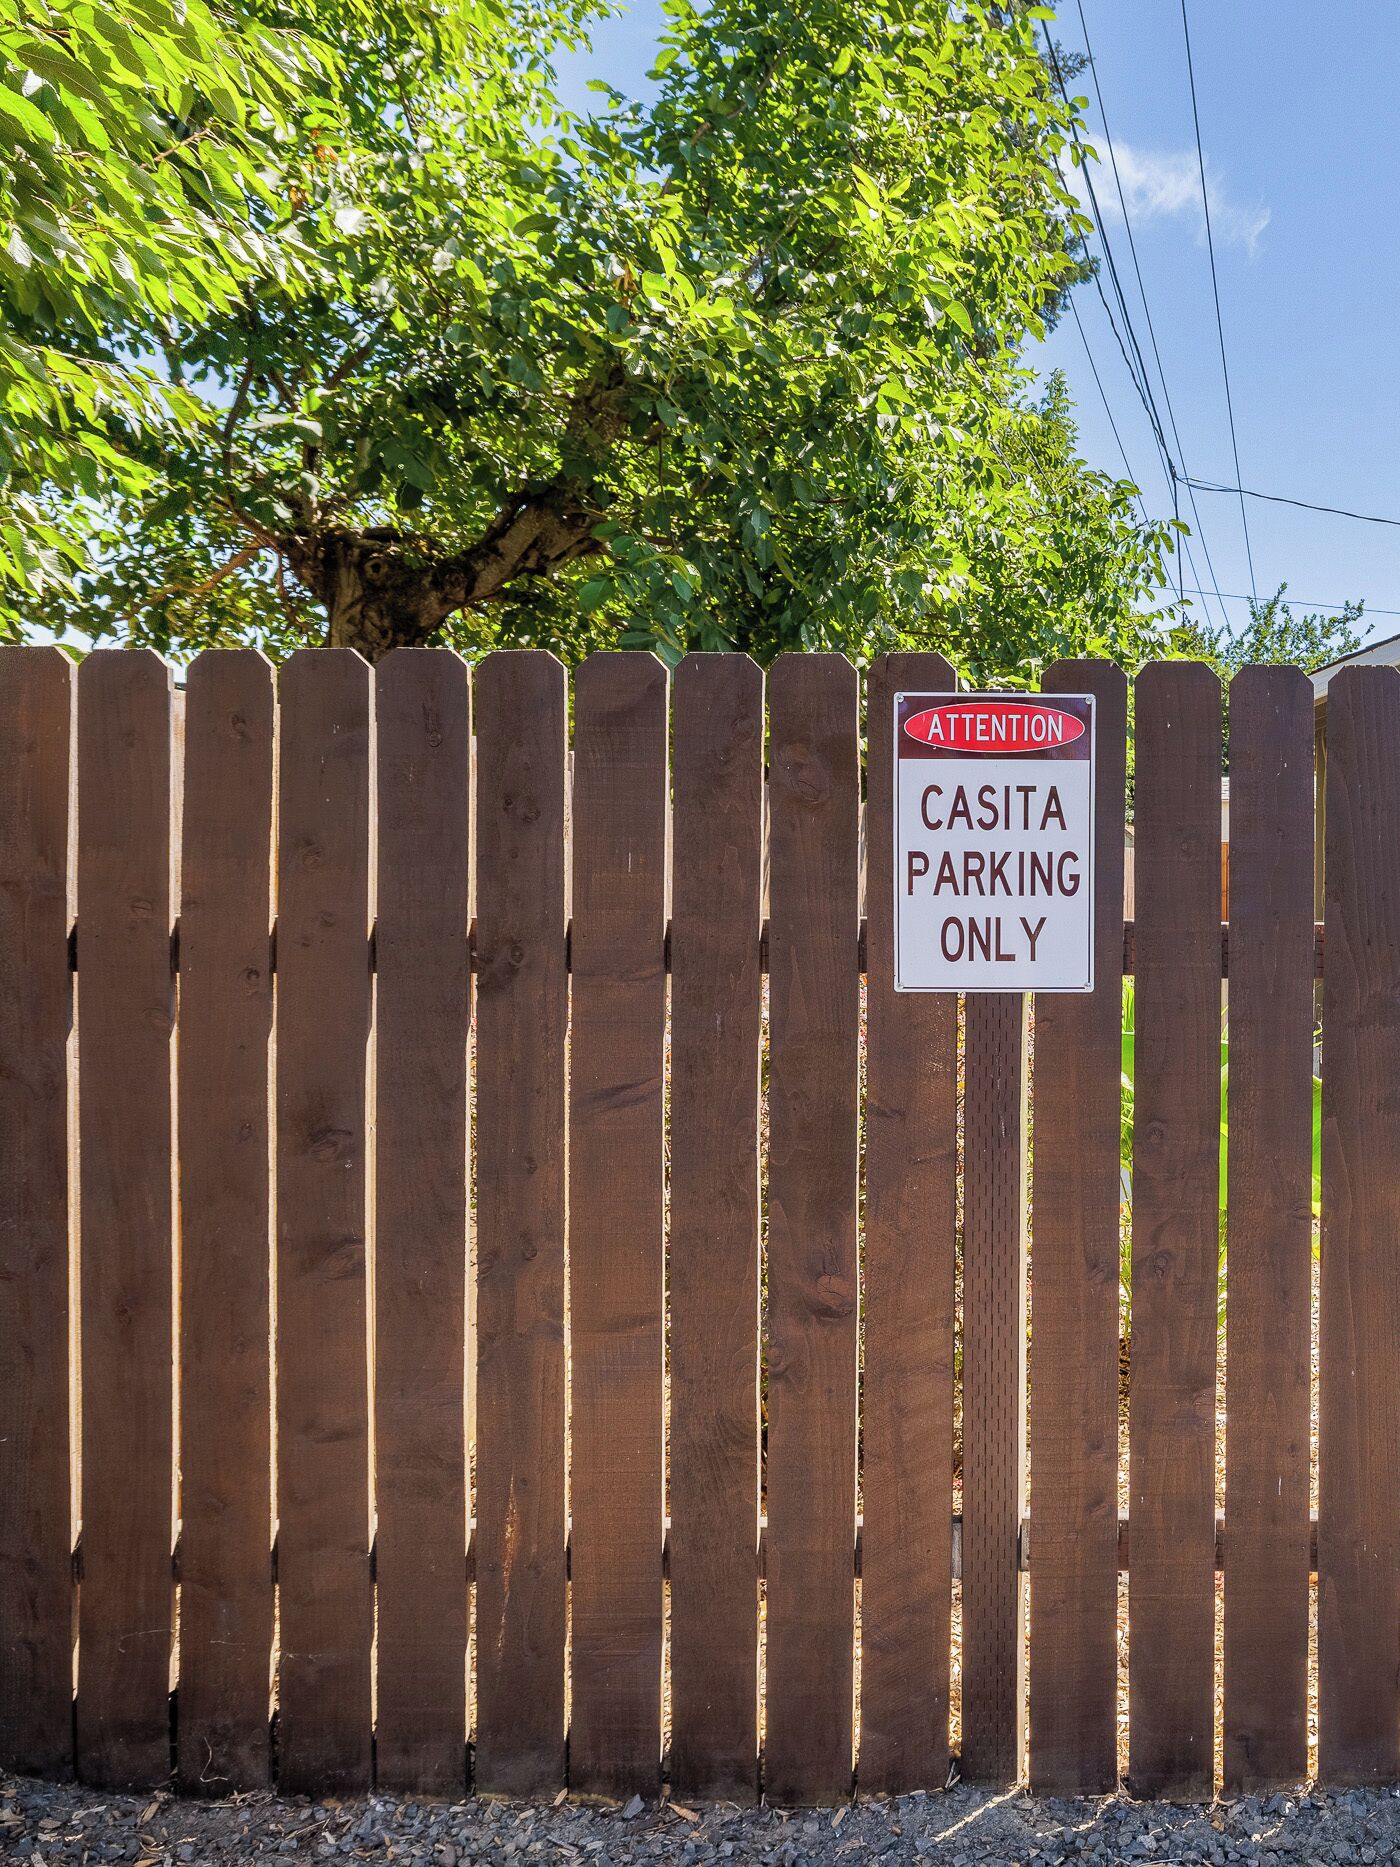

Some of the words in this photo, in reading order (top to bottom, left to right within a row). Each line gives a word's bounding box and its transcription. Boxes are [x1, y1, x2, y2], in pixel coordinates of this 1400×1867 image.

[927, 713, 1063, 742] ATTENTION
[920, 784, 1067, 831] CASITA
[907, 850, 1081, 897] PARKING
[940, 915, 1047, 963] ONLY
